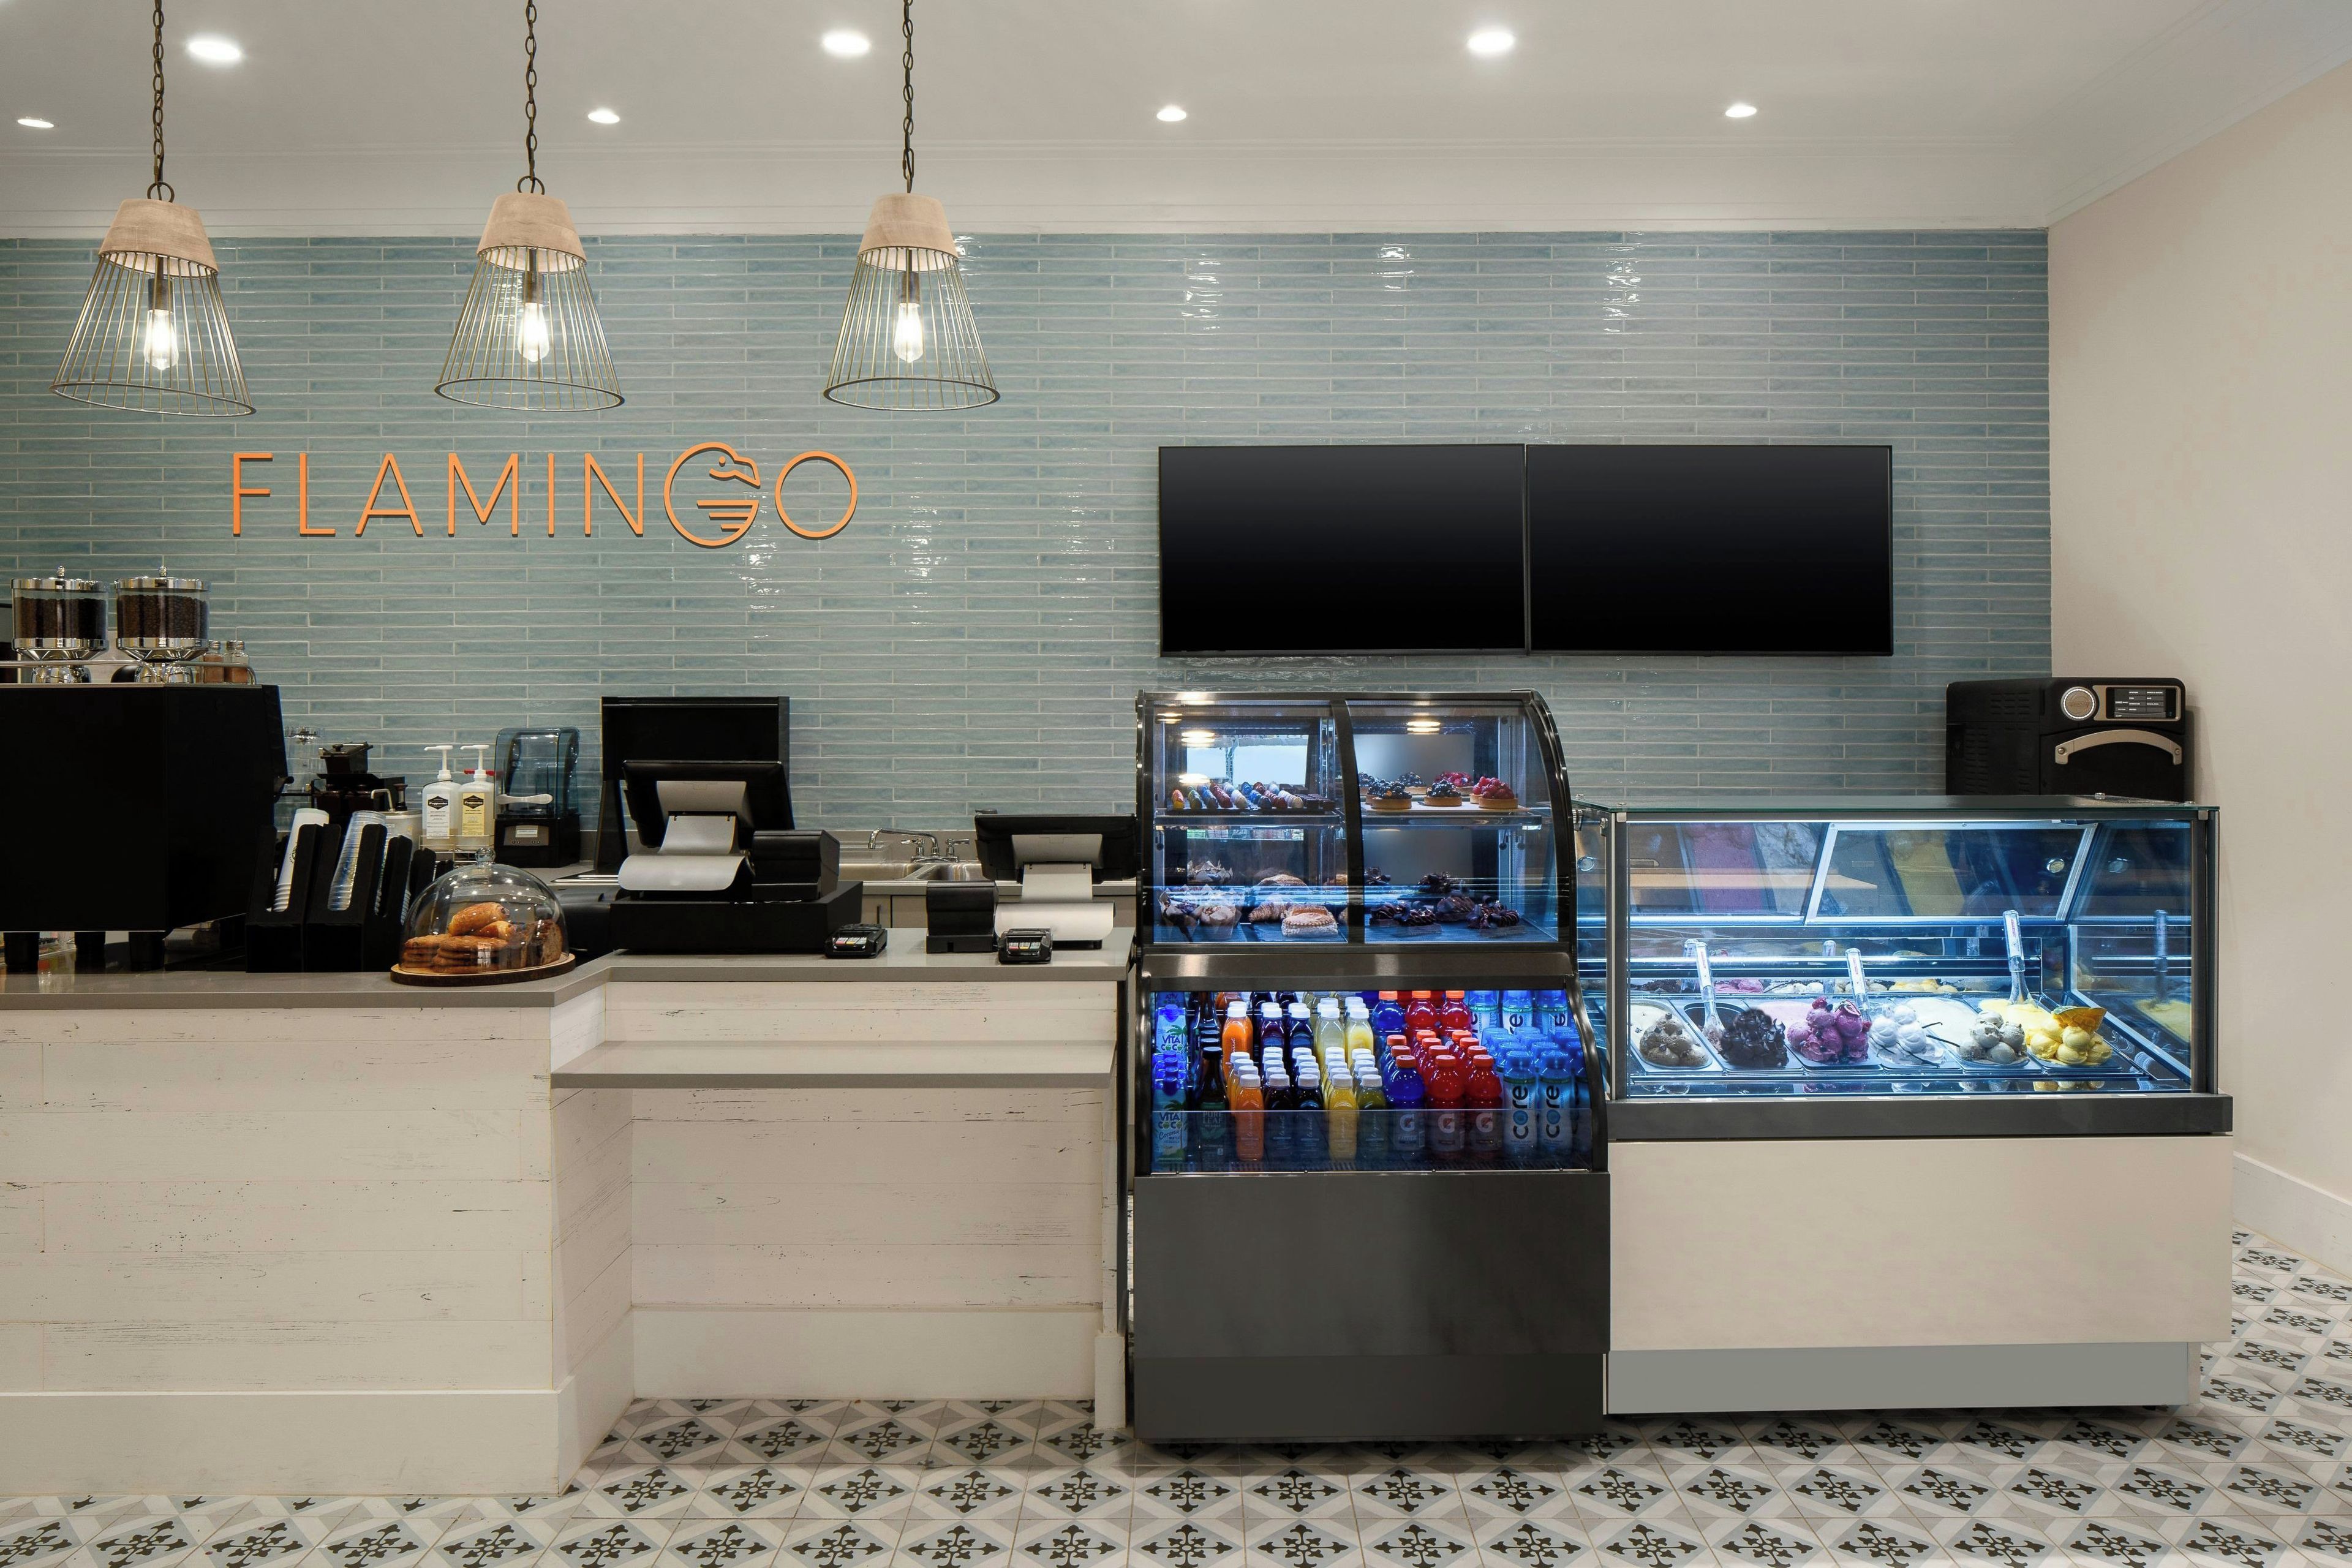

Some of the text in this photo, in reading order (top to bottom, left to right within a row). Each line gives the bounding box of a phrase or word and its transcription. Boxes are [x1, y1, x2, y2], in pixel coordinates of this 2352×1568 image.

[233, 442, 858, 548] FLAMINGO
[1162, 1035, 1181, 1044] VITA
[1159, 1112, 1180, 1121] VITA
[1512, 1086, 1529, 1139] core
[1545, 1085, 1561, 1138] core
[1400, 1114, 1415, 1132] G
[1438, 1113, 1455, 1134] G
[1476, 1112, 1493, 1133] G
